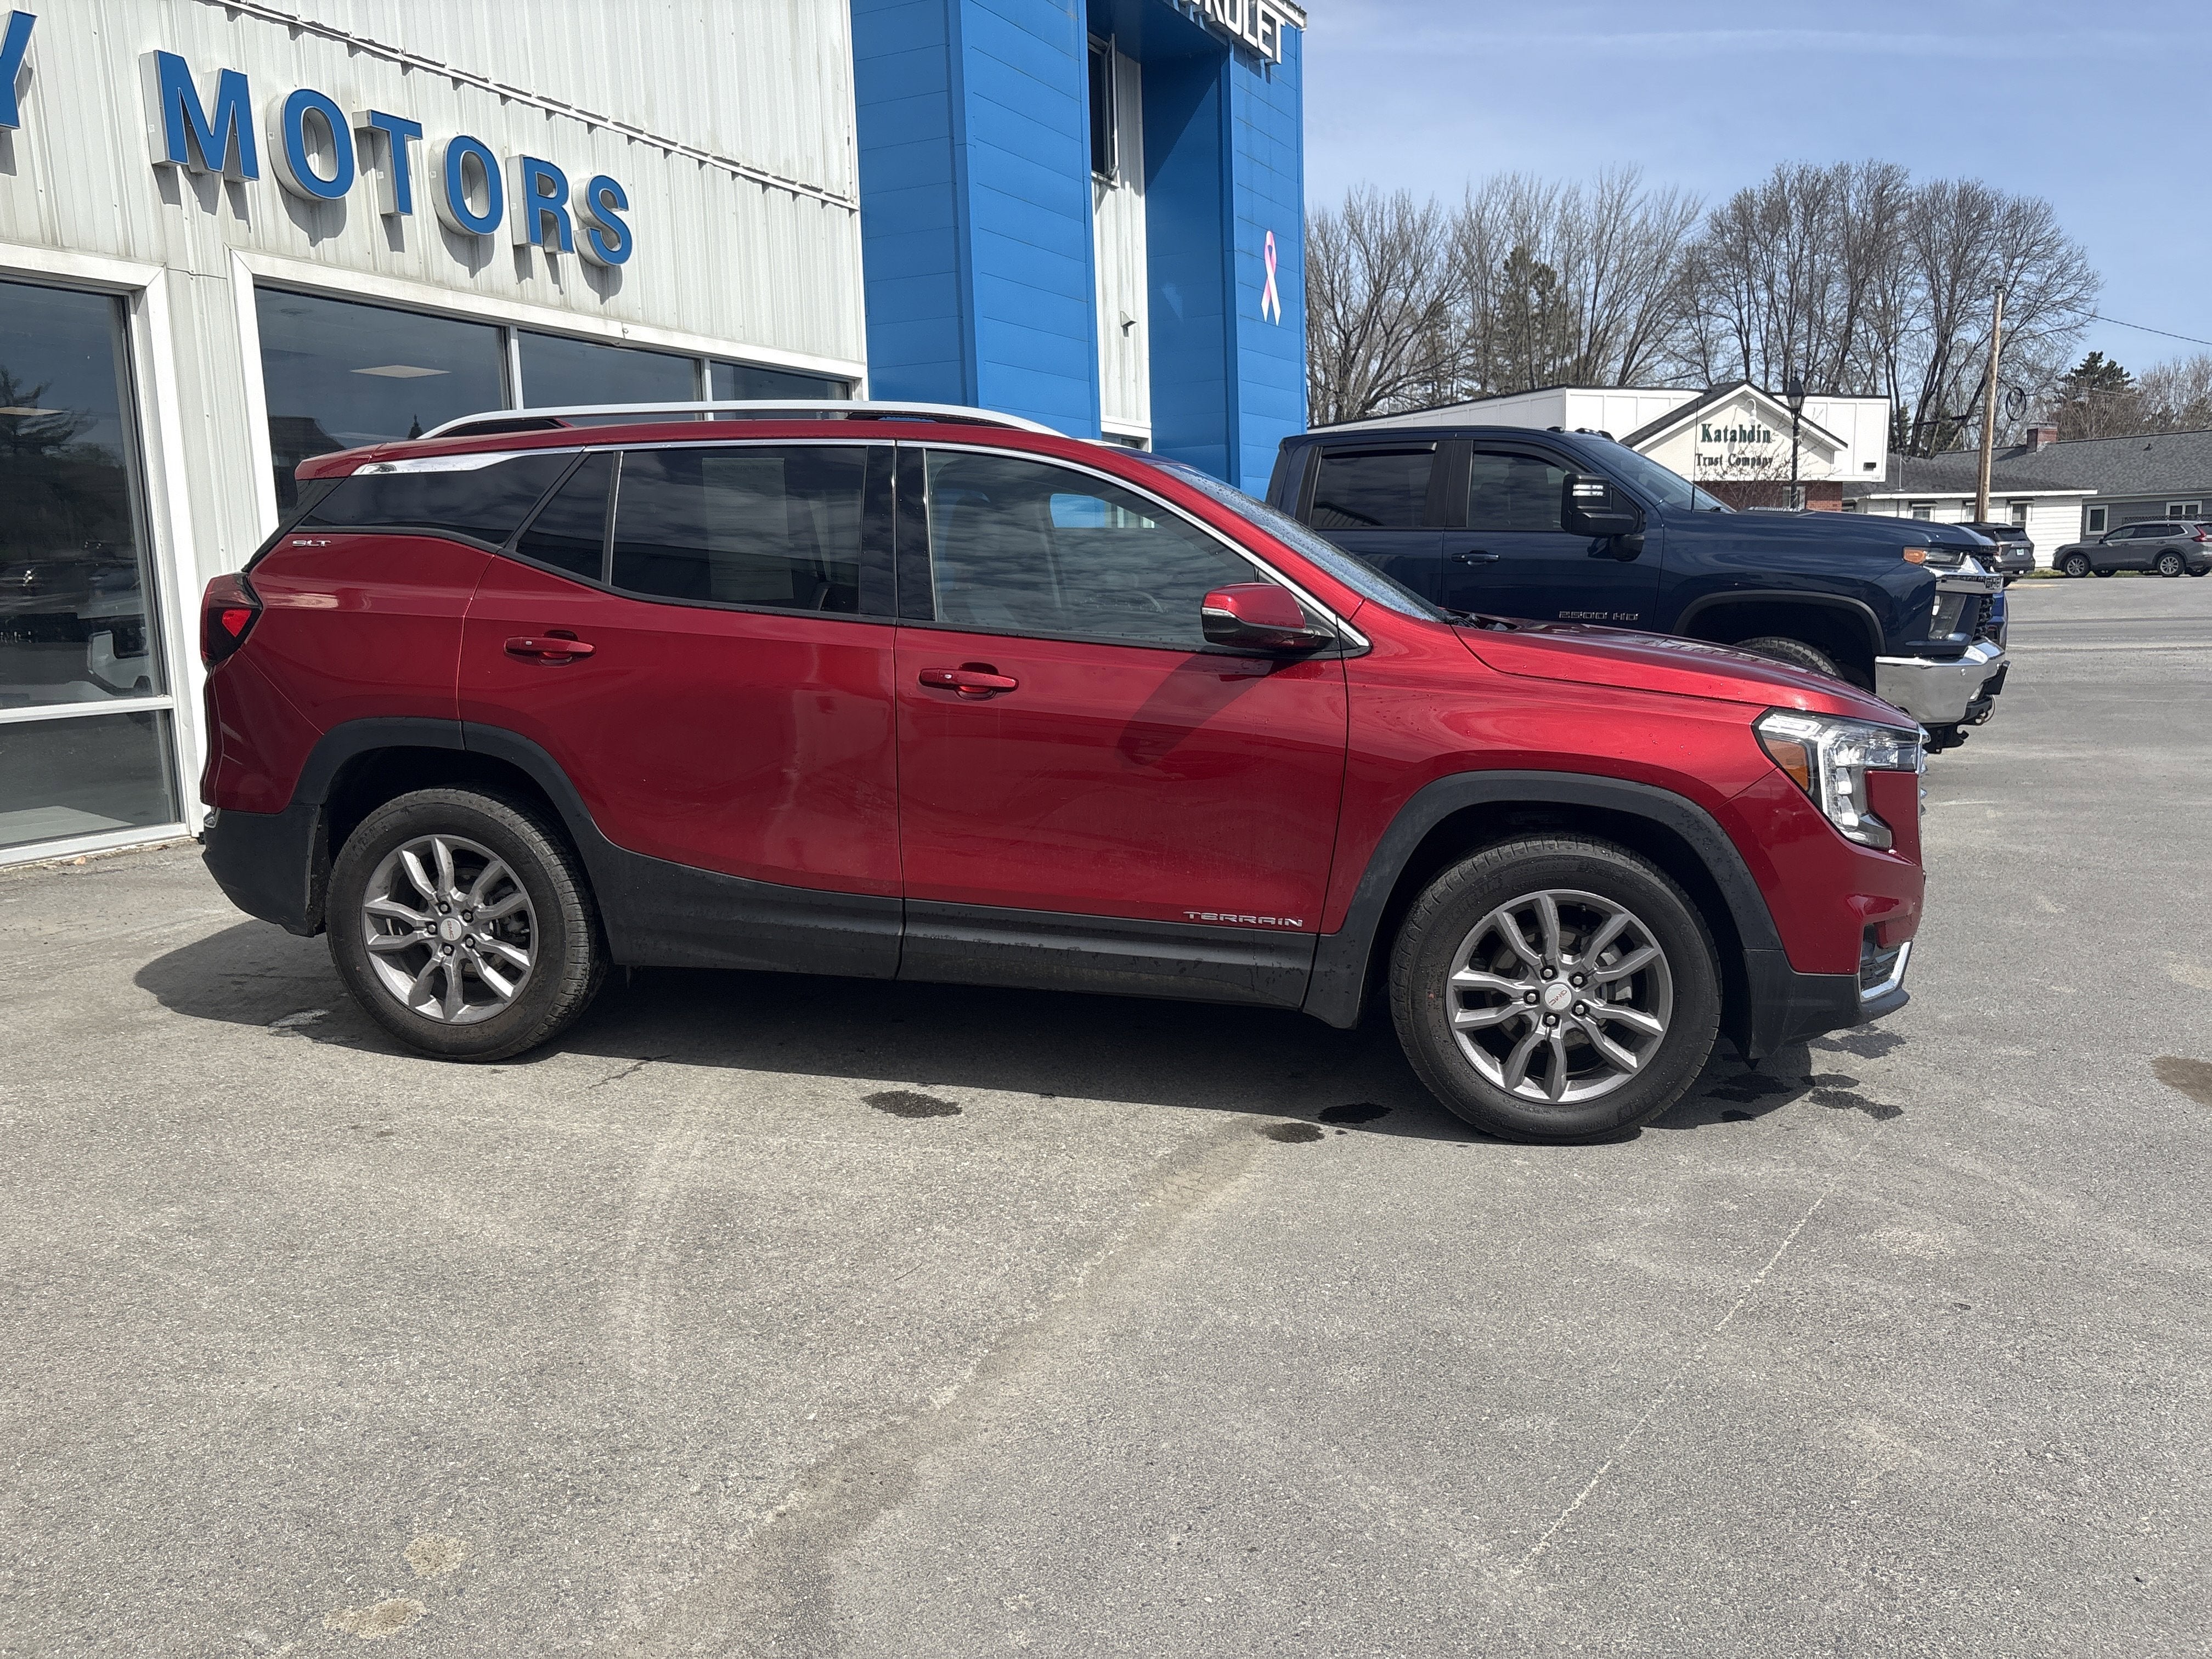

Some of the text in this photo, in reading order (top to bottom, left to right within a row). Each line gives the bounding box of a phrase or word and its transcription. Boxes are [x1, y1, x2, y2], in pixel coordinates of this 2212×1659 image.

[140, 49, 633, 267] MOTORS
[1701, 424, 1771, 443] Katahdin
[1696, 453, 1773, 469] Trust Company
[1183, 911, 1303, 927] TERRAIN
[1548, 989, 1567, 1006] GMC
